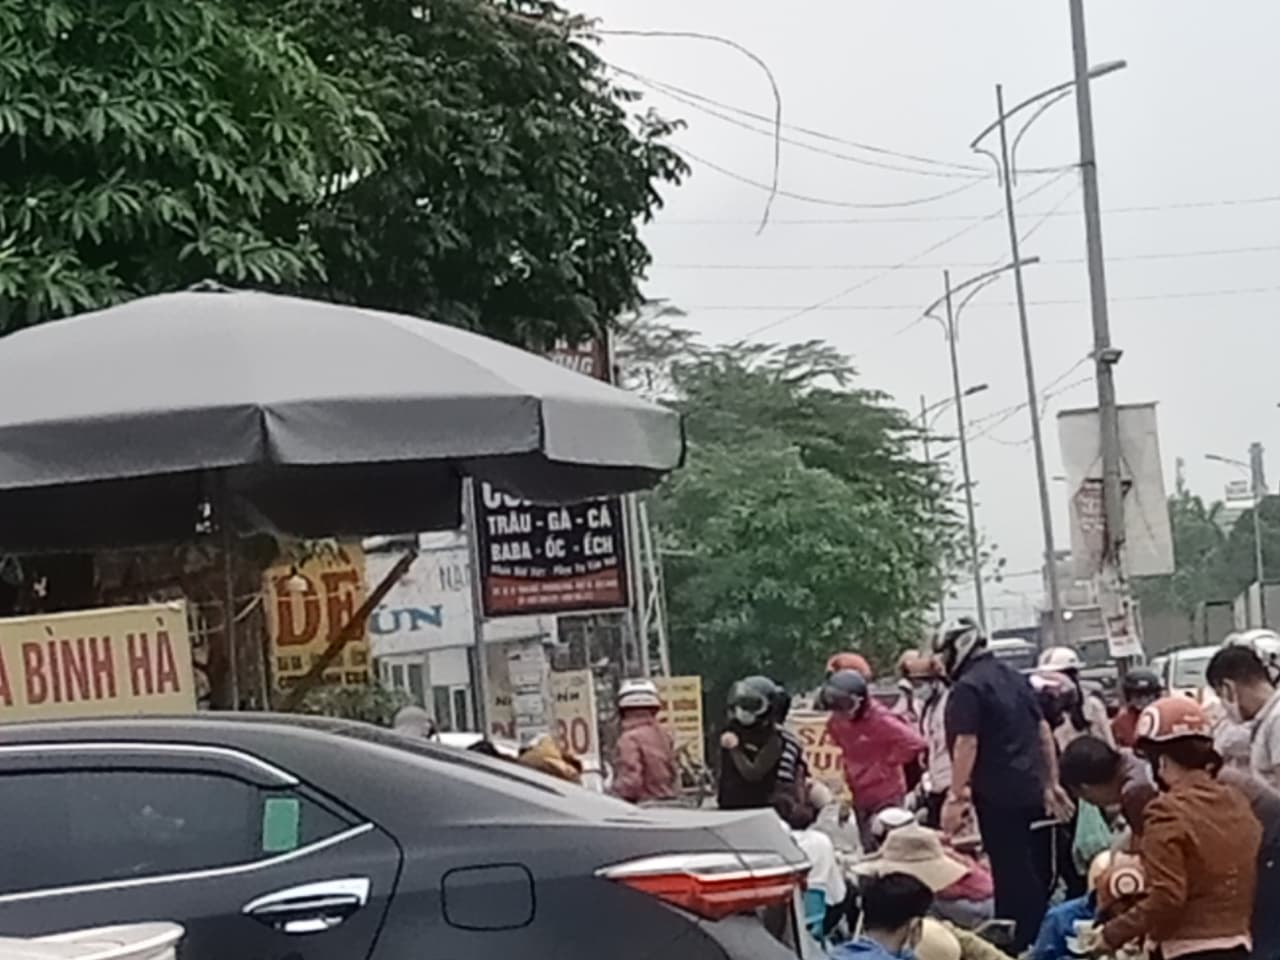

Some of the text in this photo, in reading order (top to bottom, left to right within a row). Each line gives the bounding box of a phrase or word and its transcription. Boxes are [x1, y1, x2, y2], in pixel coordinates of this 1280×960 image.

[490, 540, 533, 562] BABA
[21, 625, 117, 705] BÌNH
[126, 616, 181, 696] HÀ
